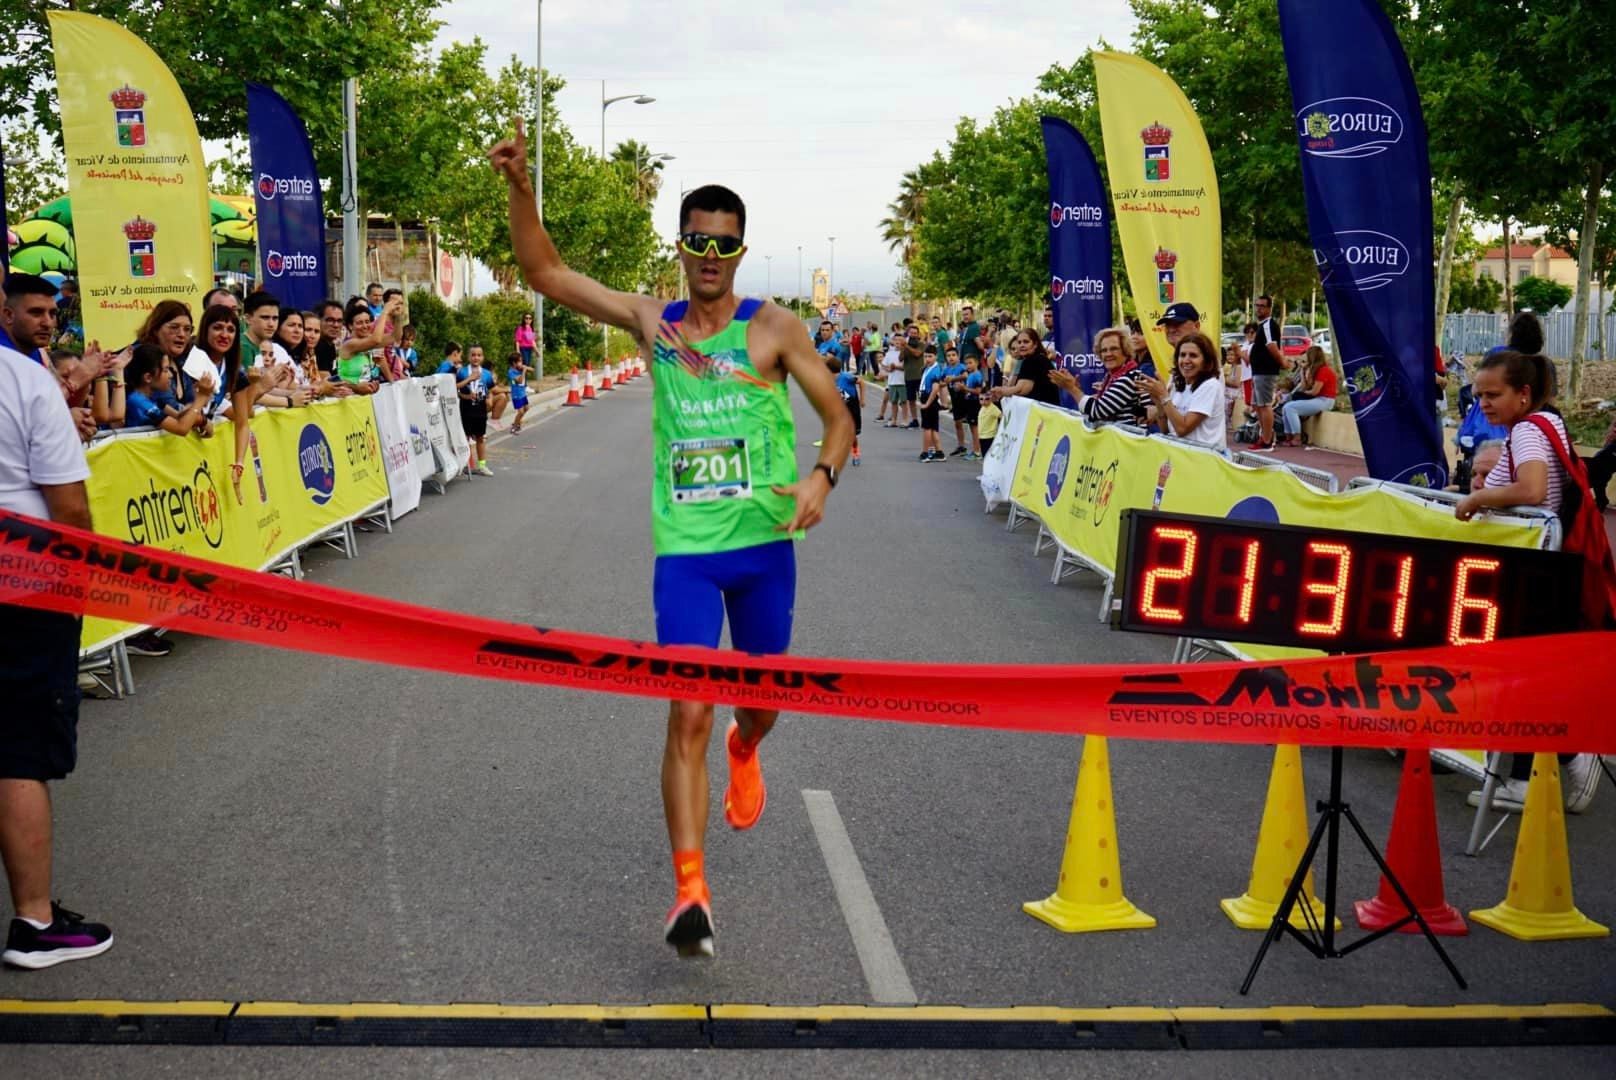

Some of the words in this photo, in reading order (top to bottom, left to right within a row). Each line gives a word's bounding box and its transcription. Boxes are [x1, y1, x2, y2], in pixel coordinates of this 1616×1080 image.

[681, 393, 748, 415] SAKATA
[691, 453, 742, 484] 201
[89, 570, 171, 596] TURISMO
[177, 602, 210, 620] 645
[215, 606, 235, 624] 22
[240, 612, 261, 629] 38
[266, 617, 288, 633] 20
[476, 653, 567, 677] EVENTOS
[572, 667, 700, 694] DEPORTIVOS
[717, 684, 804, 703] TURISMO
[808, 693, 880, 711] ACTIVO
[882, 699, 980, 715] OUTDOOR
[1109, 708, 1198, 725] EVENTOS
[1203, 710, 1321, 730] DEPORTIVOS
[1337, 715, 1417, 734] TURISMO
[1422, 716, 1485, 736] ACTIVO
[1487, 720, 1569, 738] OUTDOOR
